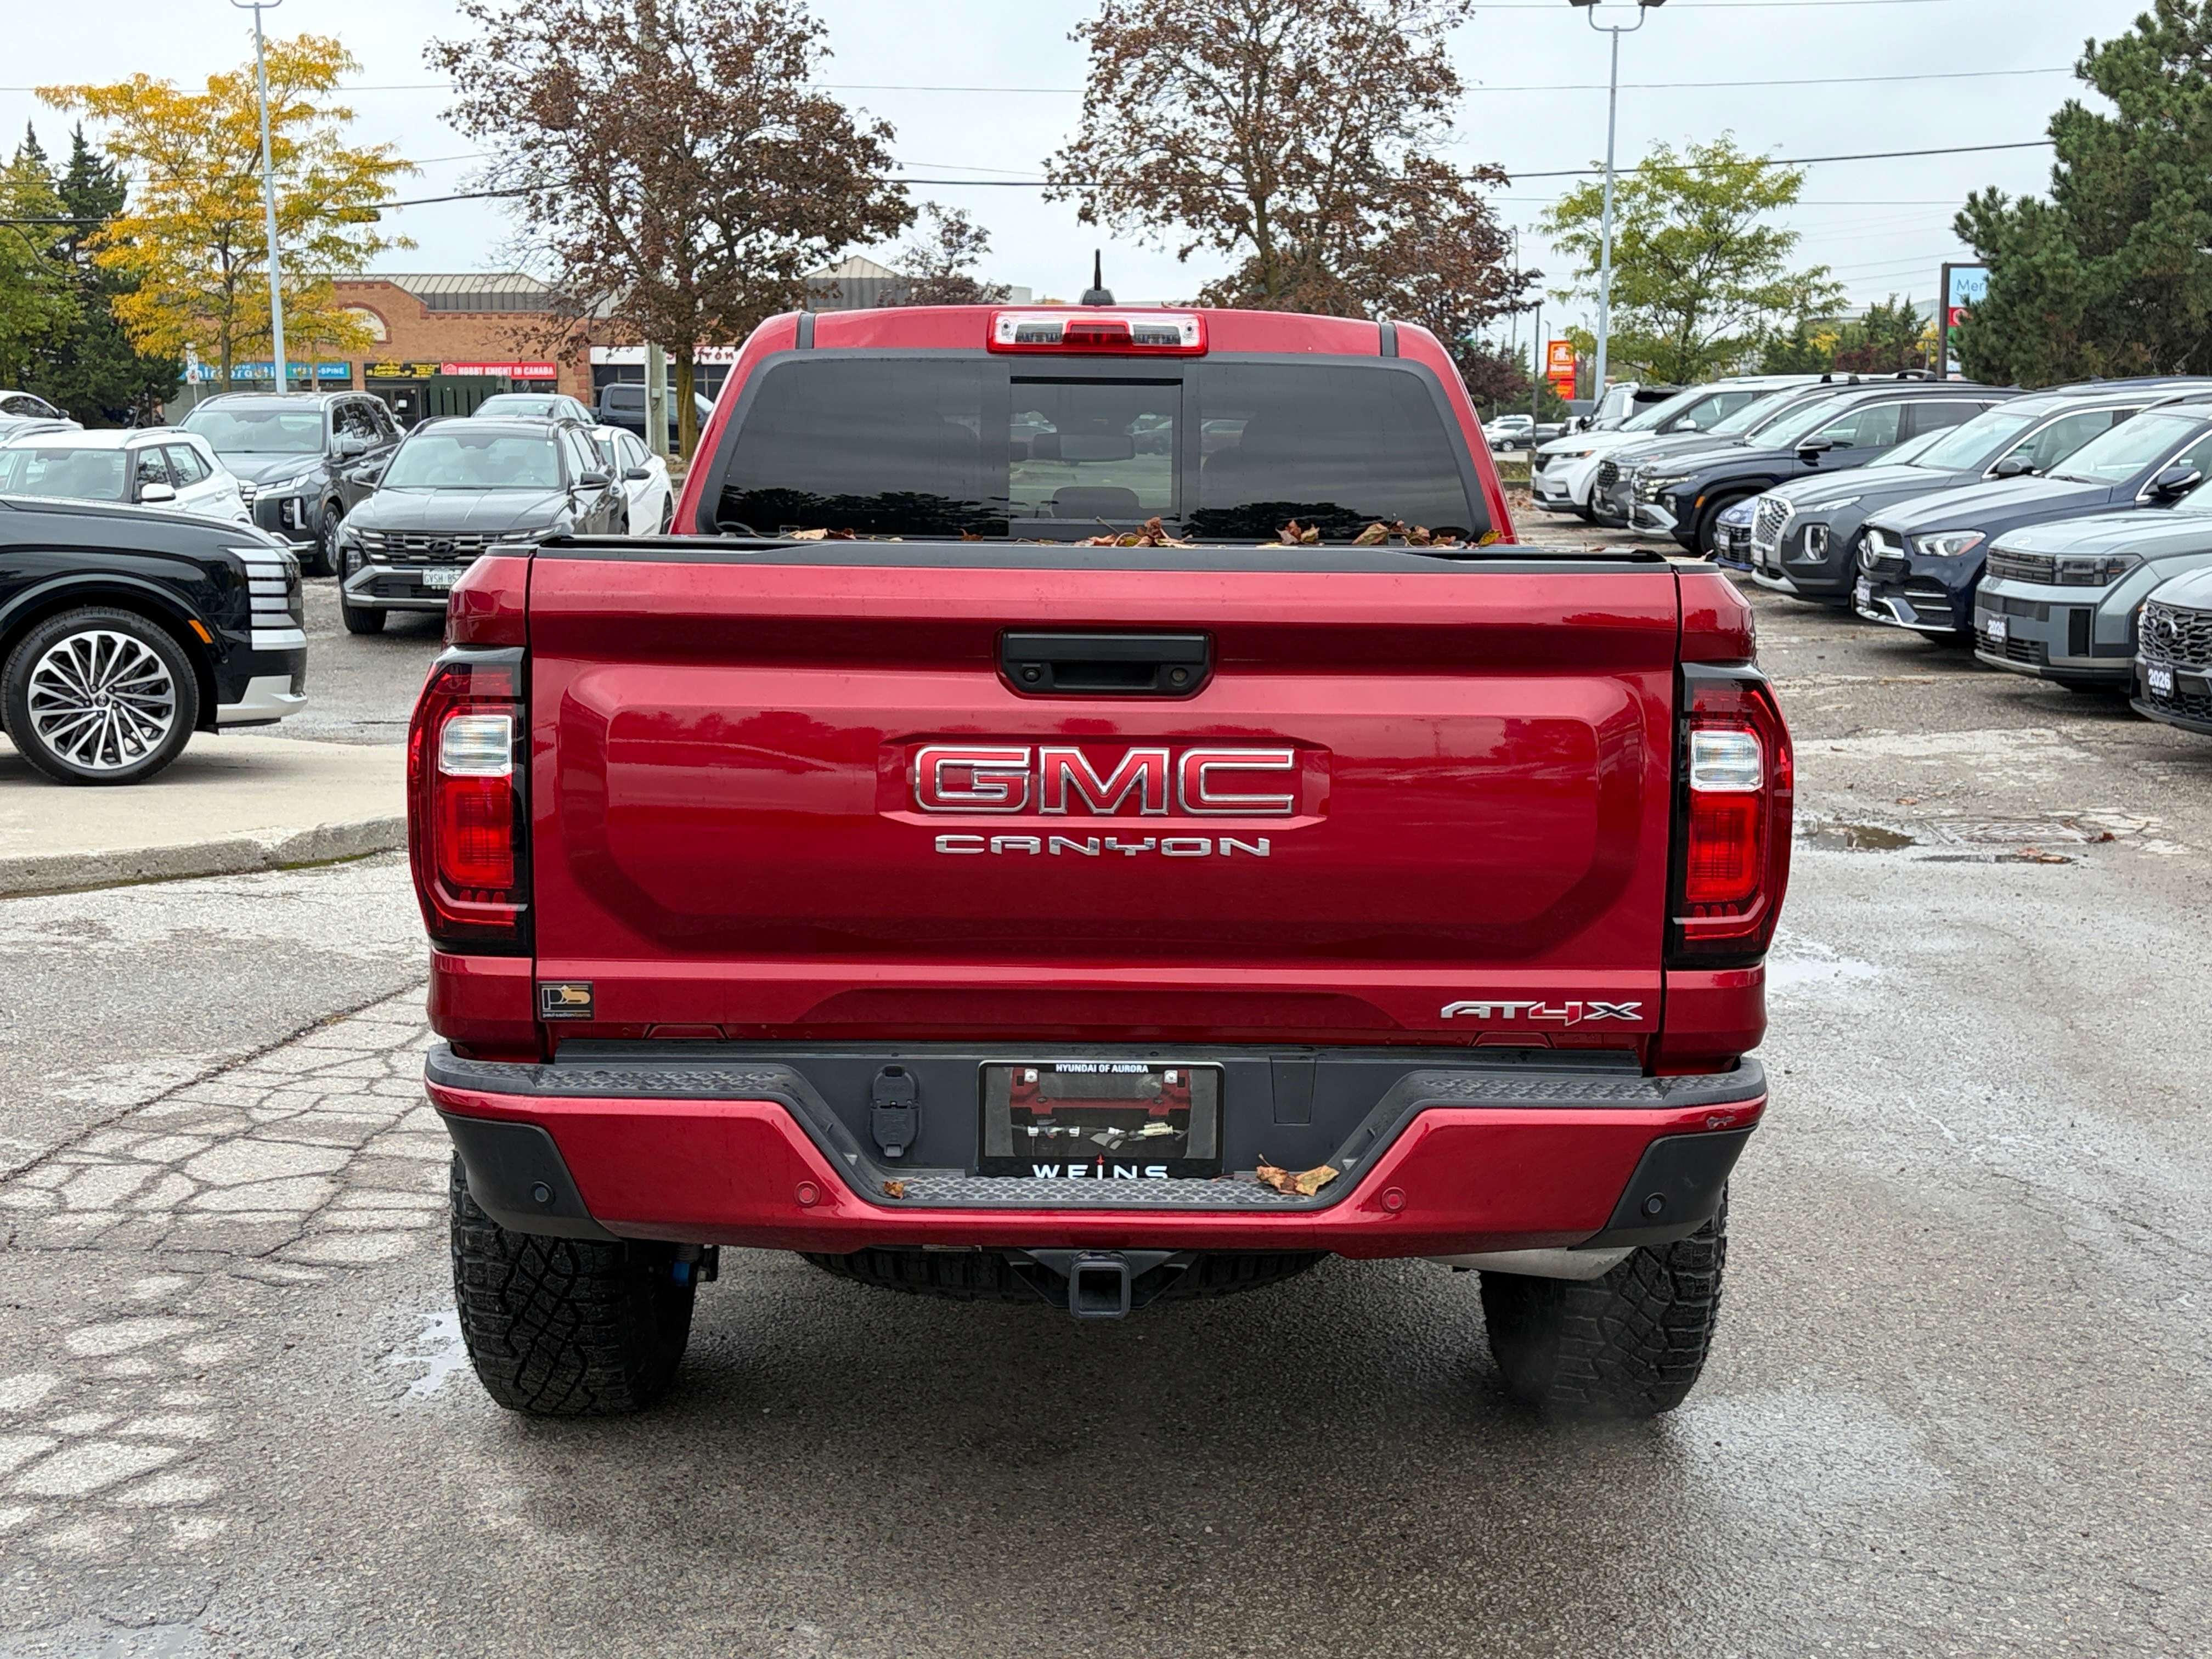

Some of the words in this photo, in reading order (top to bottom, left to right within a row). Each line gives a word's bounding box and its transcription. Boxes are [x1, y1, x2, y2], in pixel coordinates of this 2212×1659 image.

[1956, 279, 1988, 292] Mer
[425, 573, 443, 583] GVSH
[2147, 668, 2171, 690] 2026
[915, 746, 1295, 815] GMC
[935, 834, 1271, 858] CANYON
[1440, 1001, 1644, 1027] AT4X
[1056, 1064, 1097, 1073] HYUNDAI
[1098, 1064, 1110, 1073] OF
[1111, 1064, 1149, 1074] AURORA
[1031, 1163, 1169, 1180] WEINS
